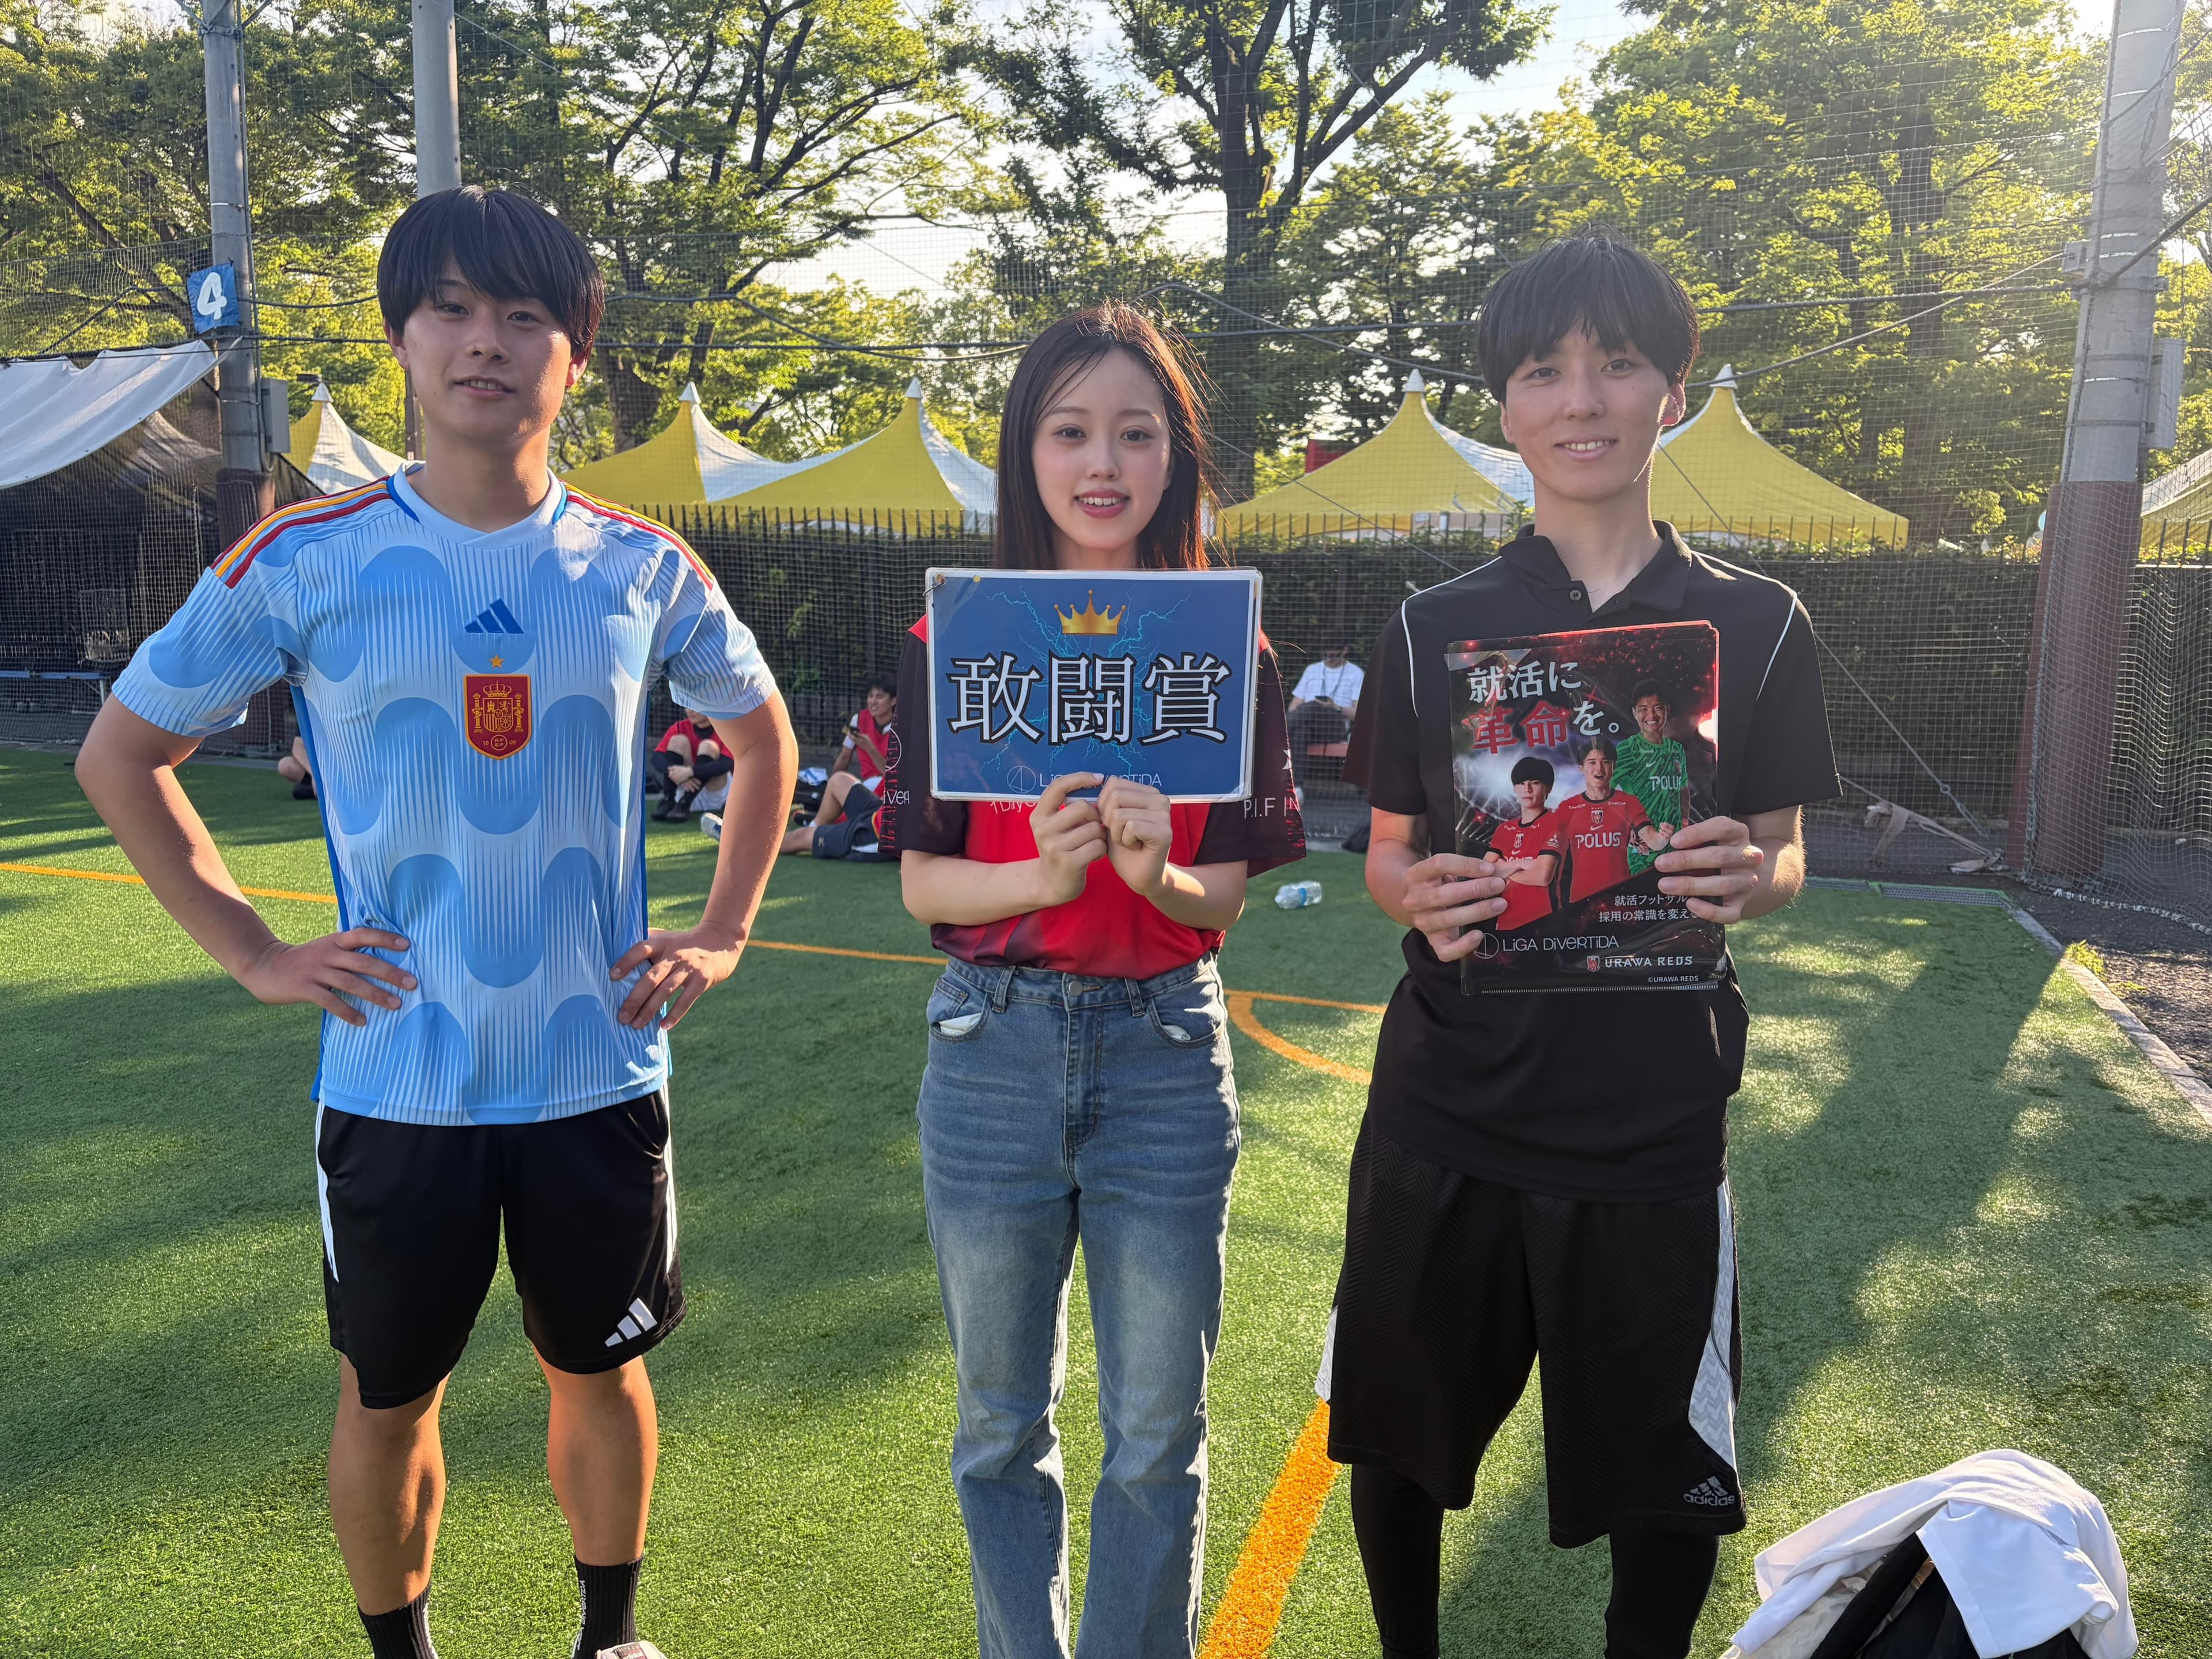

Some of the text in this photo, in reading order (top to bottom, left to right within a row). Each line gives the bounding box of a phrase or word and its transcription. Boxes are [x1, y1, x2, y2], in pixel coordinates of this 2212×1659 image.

[197, 272, 227, 320] 4
[946, 650, 1232, 746] 敢闘賞
[1467, 660, 1581, 703] 就活に
[1470, 700, 1619, 755] 革命を。
[1575, 832, 1622, 849] POLUS
[1605, 956, 1693, 968] URAWA REDS
[1683, 1493, 1735, 1506] adidas
